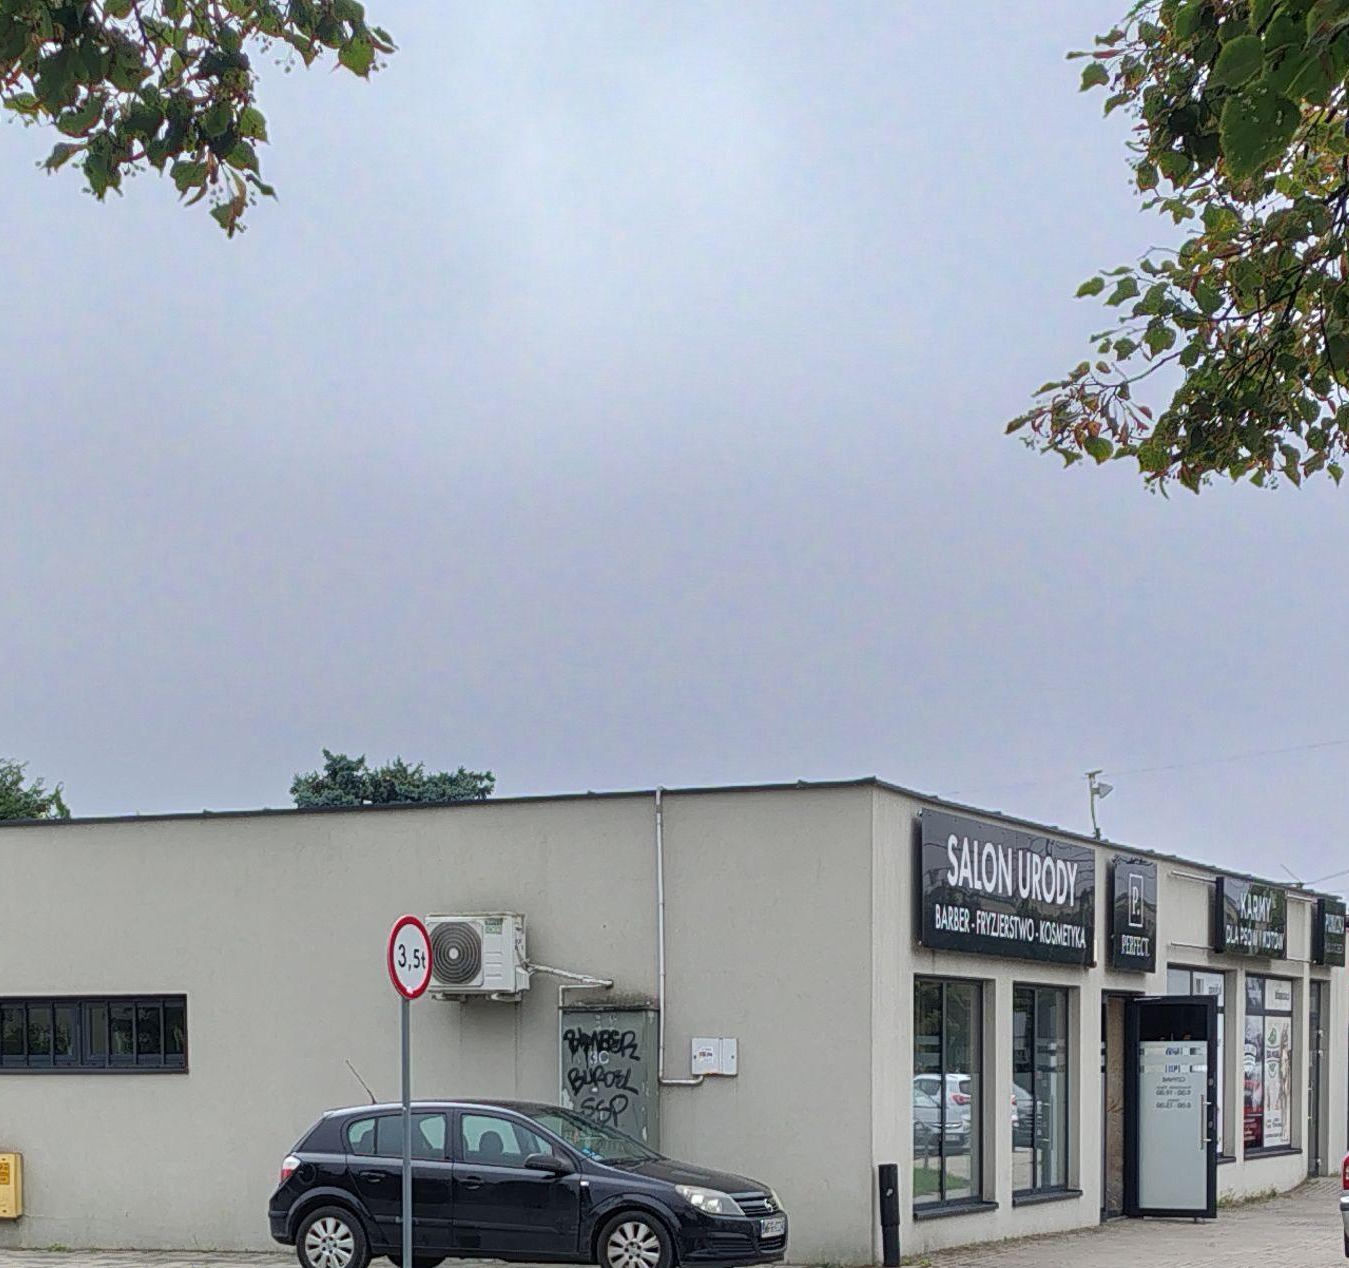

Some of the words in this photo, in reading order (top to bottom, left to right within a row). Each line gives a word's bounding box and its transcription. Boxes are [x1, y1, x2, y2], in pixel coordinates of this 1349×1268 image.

[947, 834, 1013, 897] SALON
[1018, 850, 1078, 907] URODY
[935, 904, 970, 934] BARBER
[976, 910, 1034, 942] FRYZJERSTWO
[1039, 920, 1087, 949] KOSMETYKA
[1240, 892, 1272, 922] KARMY
